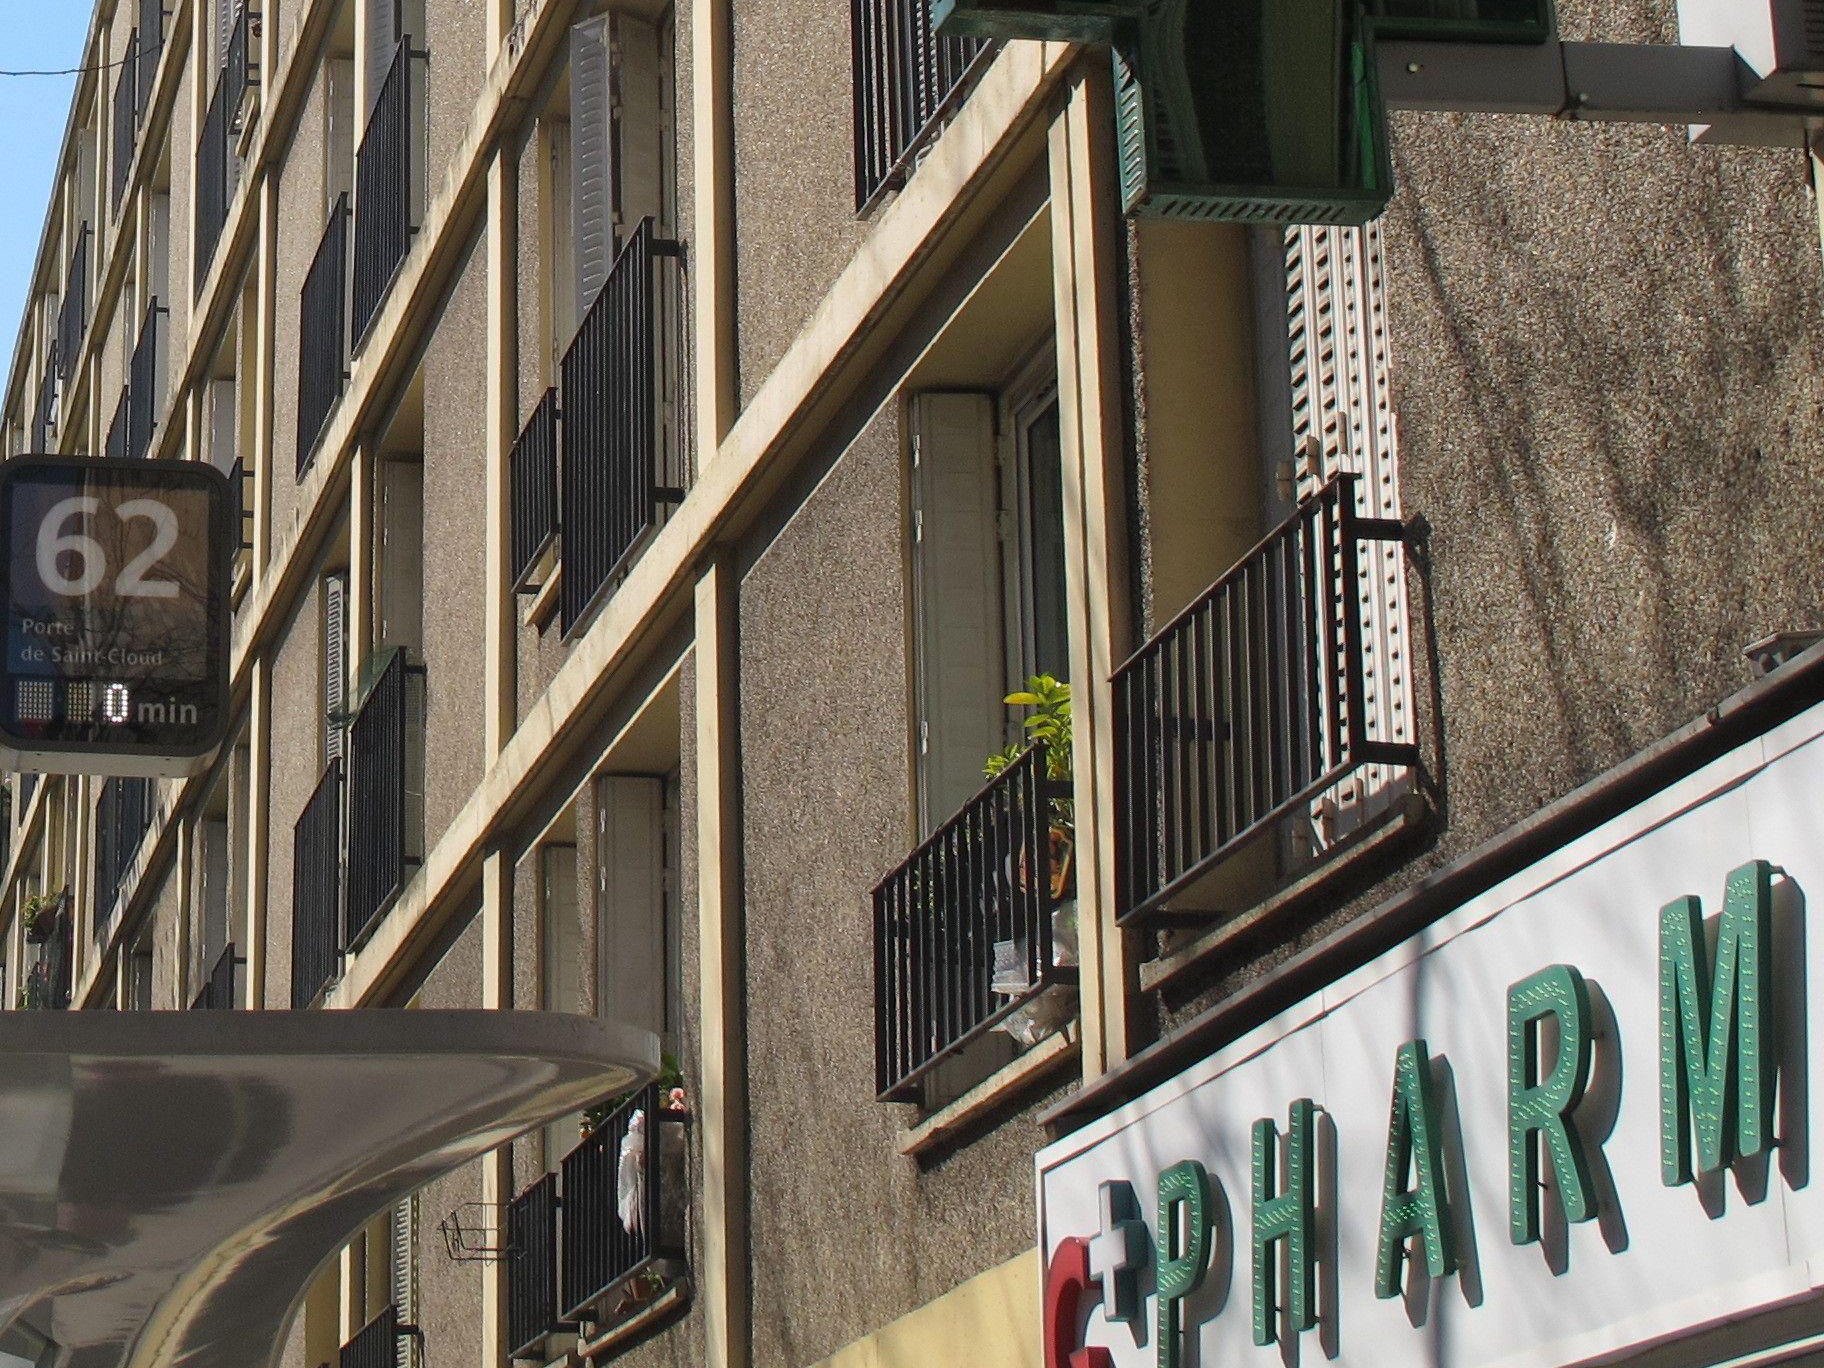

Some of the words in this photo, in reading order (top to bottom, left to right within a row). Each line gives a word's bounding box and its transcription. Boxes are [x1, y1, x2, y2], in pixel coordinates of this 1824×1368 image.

[35, 496, 180, 598] 62
[22, 618, 75, 636] Porte
[20, 645, 45, 662] de
[105, 682, 130, 724] 0
[137, 697, 198, 725] min
